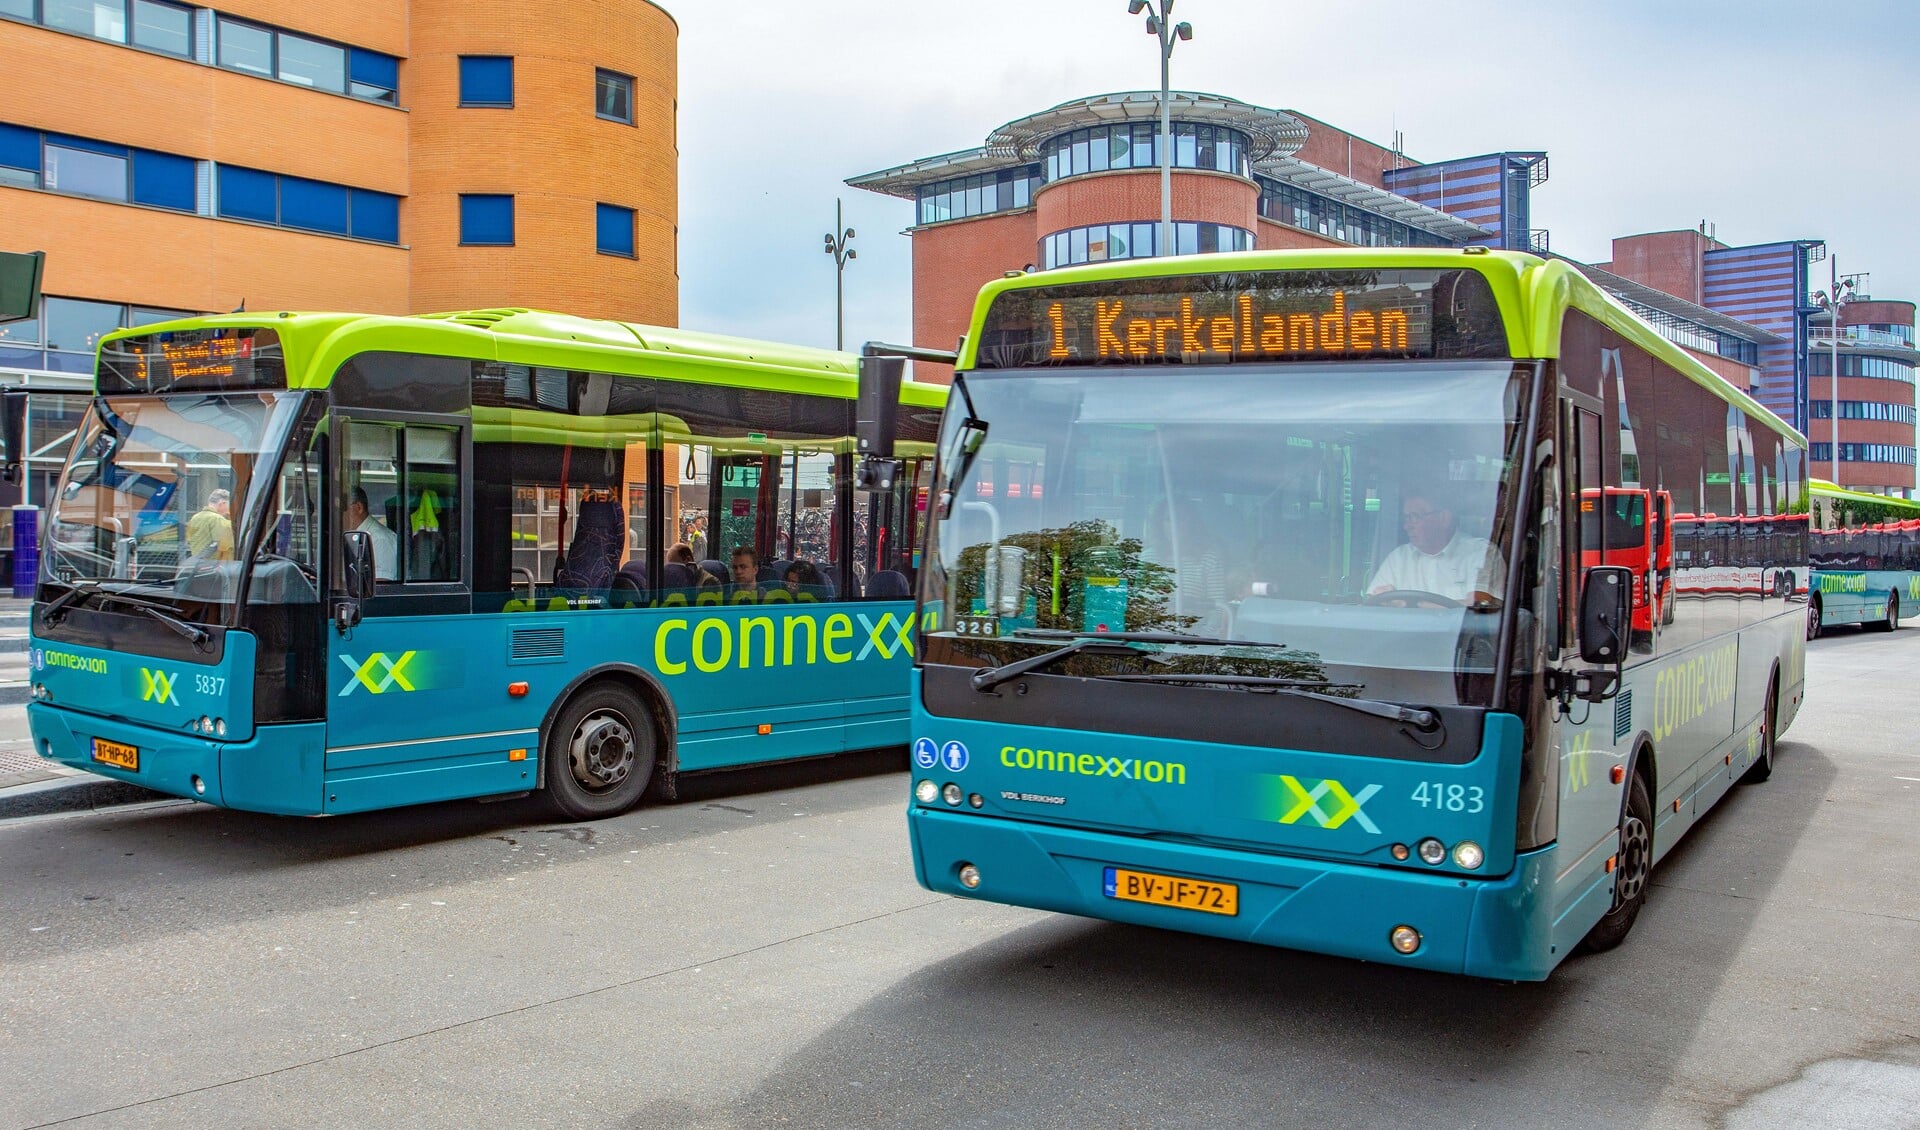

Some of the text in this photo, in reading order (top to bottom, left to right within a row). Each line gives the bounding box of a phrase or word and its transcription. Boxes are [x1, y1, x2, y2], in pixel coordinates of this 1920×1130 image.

[1048, 291, 1408, 357] 1 Kerkelanden
[1821, 574, 1867, 592] connexxion
[956, 620, 994, 635] 326
[44, 650, 108, 674] connexxion
[195, 674, 226, 697] 5837
[1654, 643, 1738, 743] connexxion
[97, 742, 134, 765] BT-HP-68
[1000, 746, 1187, 785] connexxion
[1000, 791, 1067, 805] VDL BERKHOF
[1411, 781, 1485, 814] 4183
[1128, 875, 1225, 909] BV-JF-72
